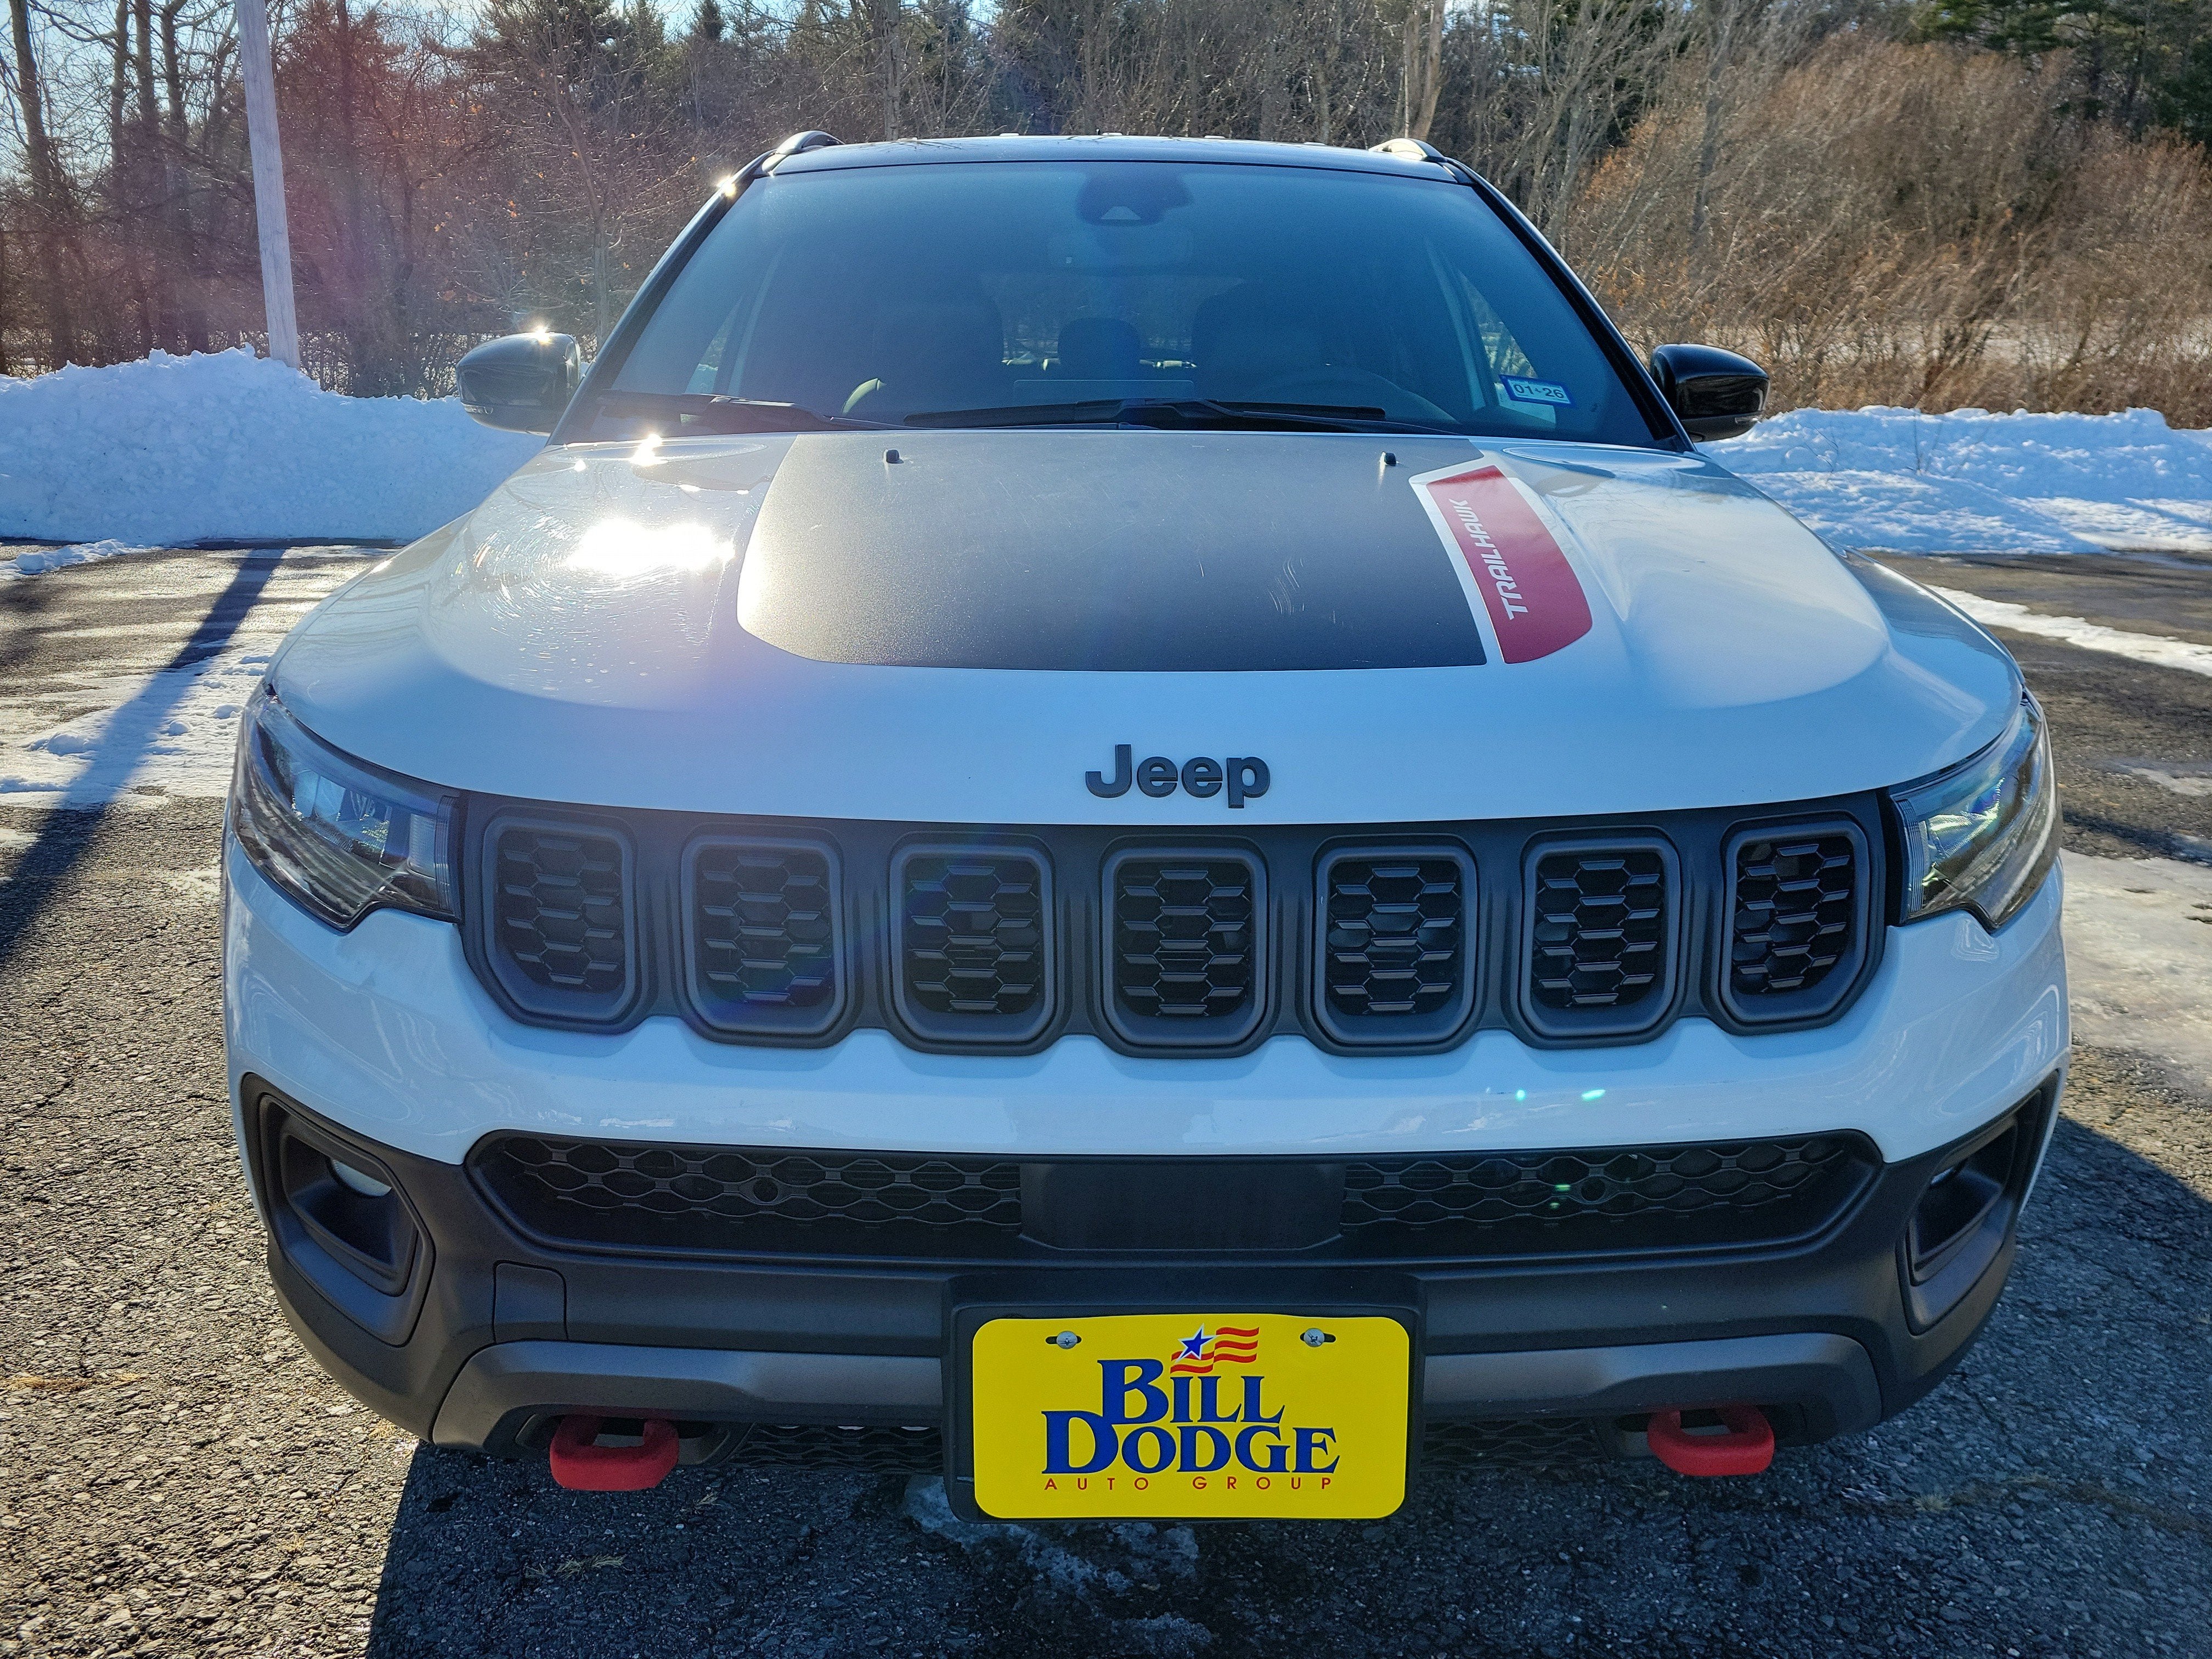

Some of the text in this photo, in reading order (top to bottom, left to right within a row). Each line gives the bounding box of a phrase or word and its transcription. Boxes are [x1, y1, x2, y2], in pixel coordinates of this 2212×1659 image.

[1448, 498, 1528, 620] TRAILHAWK
[1085, 743, 1271, 809] Jeep
[1097, 1359, 1285, 1424] BILL
[1041, 1410, 1340, 1474] DODGE
[1044, 1476, 1330, 1491] AUTO GROUP
